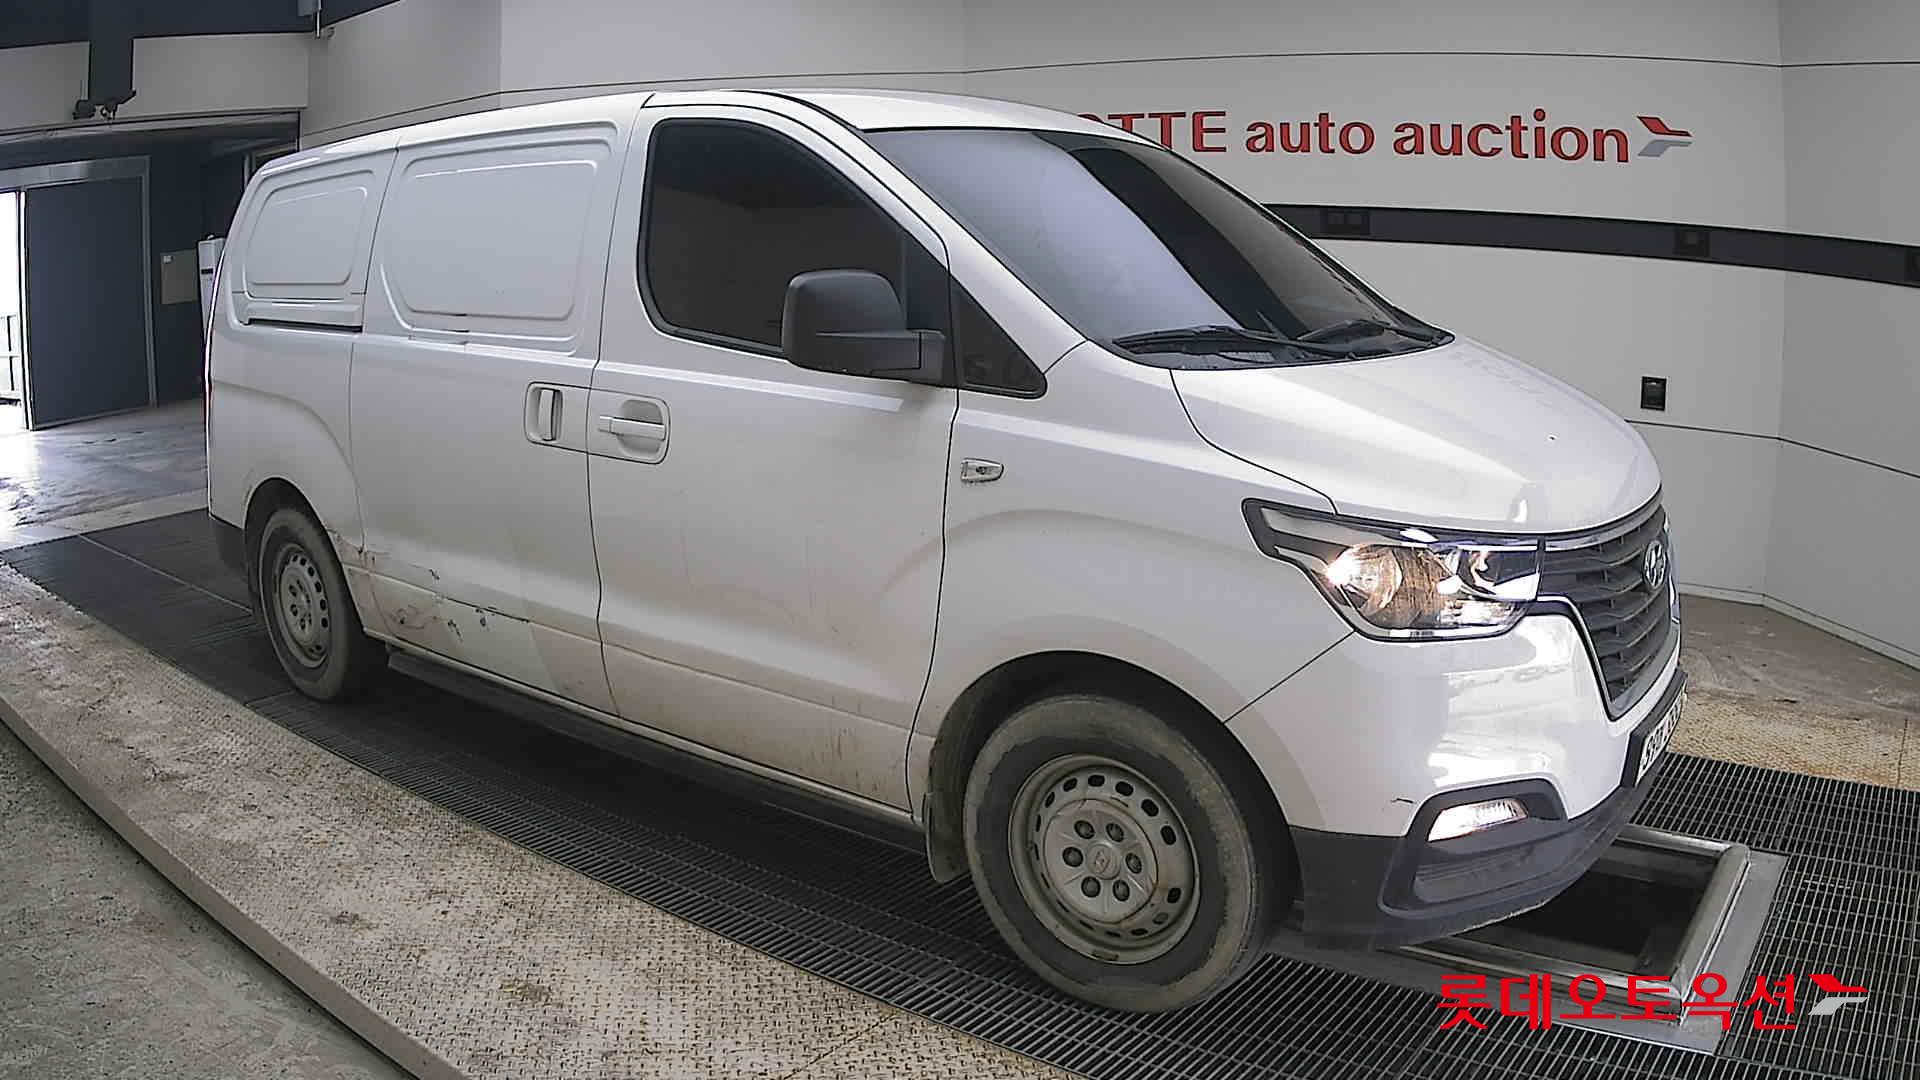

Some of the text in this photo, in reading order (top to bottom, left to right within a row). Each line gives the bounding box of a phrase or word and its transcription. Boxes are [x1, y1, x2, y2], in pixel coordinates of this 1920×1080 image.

[1078, 109, 1630, 162] TTE auto auction
